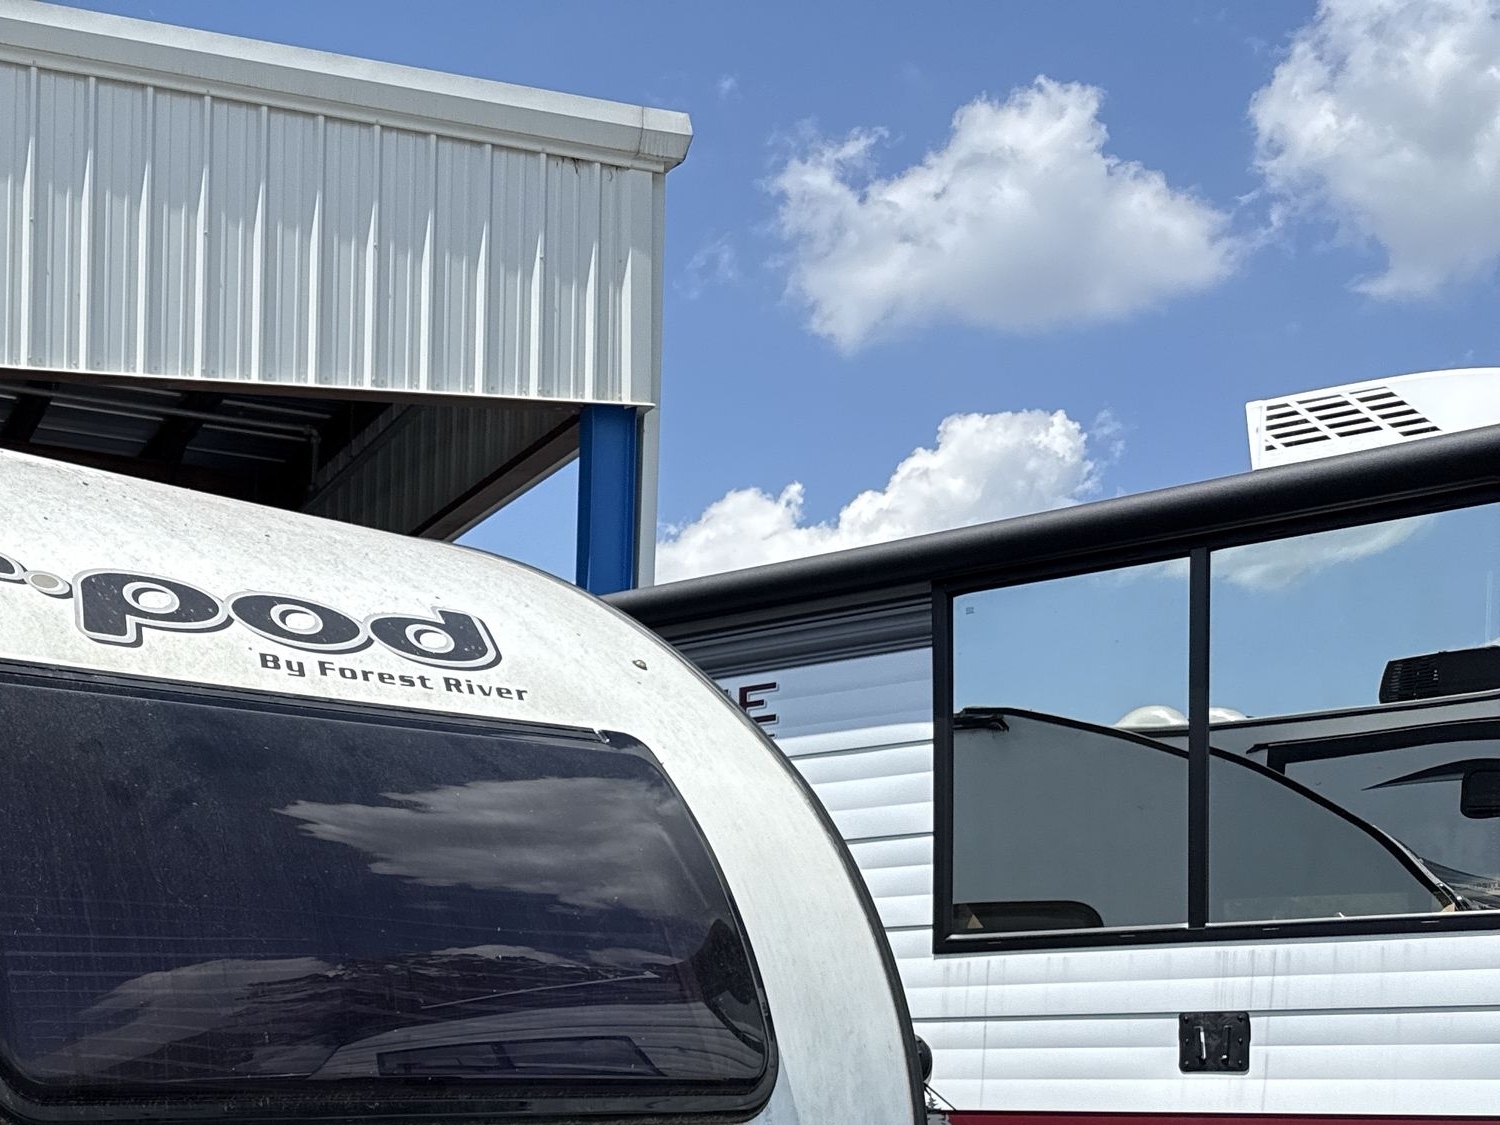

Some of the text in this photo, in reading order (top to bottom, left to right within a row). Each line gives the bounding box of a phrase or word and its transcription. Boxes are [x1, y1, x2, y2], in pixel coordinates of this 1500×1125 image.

[259, 652, 529, 701] By Forest River
